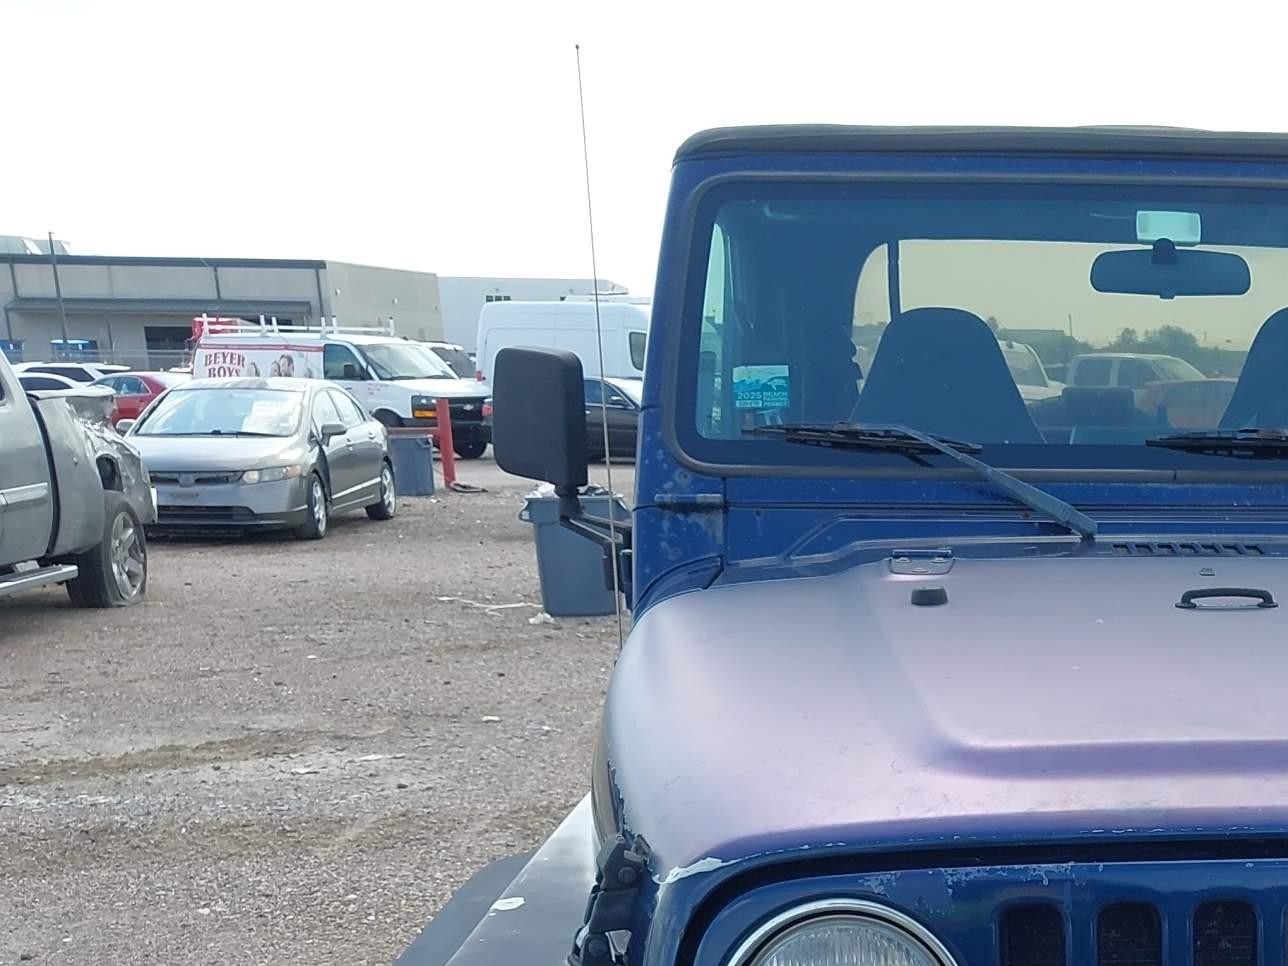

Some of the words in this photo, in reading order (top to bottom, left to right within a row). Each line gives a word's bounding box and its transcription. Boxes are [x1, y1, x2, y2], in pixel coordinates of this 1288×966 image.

[204, 351, 246, 368] BEYER
[207, 366, 241, 378] BOYS
[737, 391, 762, 400] 2025
